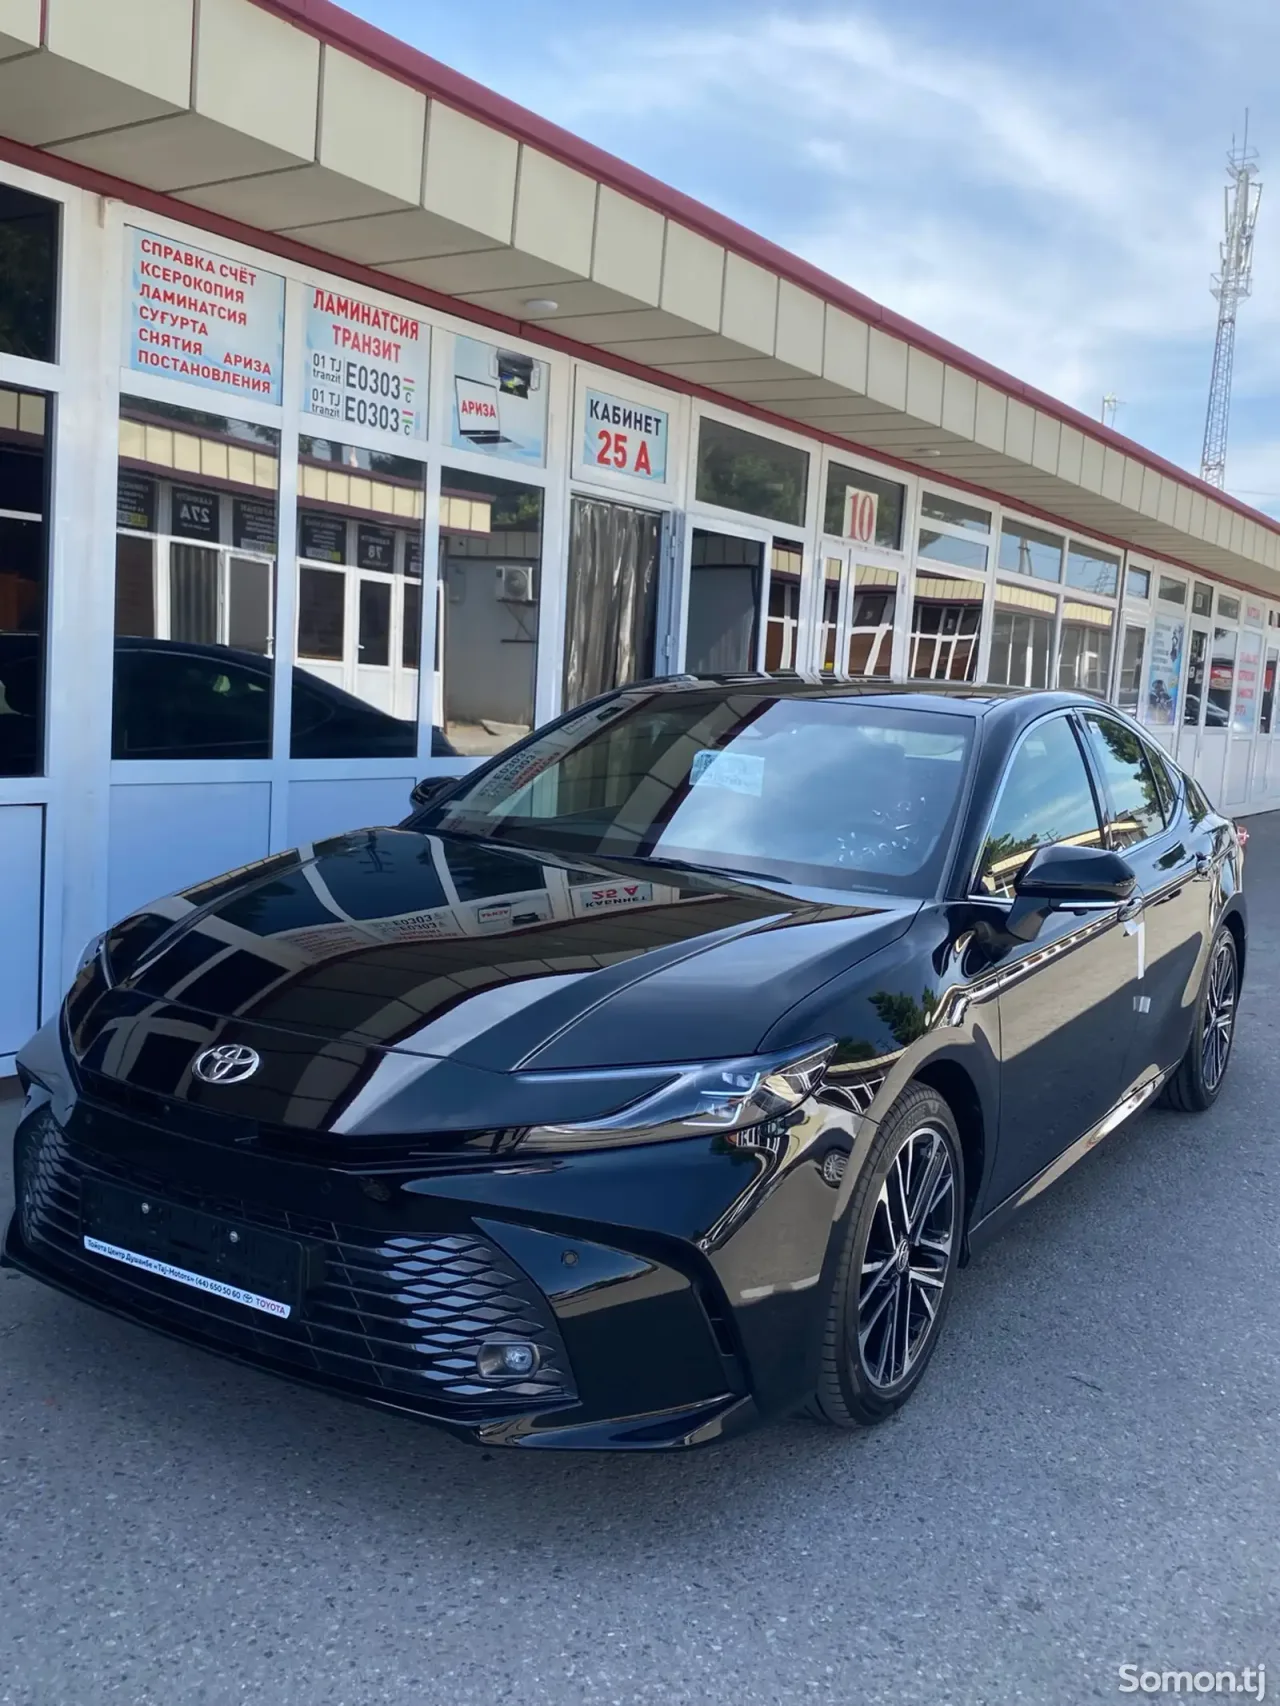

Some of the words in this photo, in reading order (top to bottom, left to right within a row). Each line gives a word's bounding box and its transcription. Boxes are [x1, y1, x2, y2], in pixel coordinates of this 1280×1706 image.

[140, 260, 244, 304] КСЕРОКОПИЯ
[141, 239, 214, 274] СПРАВКА
[219, 265, 257, 287] СЧЁТ
[139, 283, 247, 326] ЛАМИНАТСИЯ
[313, 289, 419, 341] ЛАМИНАТСИЯ
[138, 328, 203, 356] СНЯТИЯ
[223, 352, 272, 376] АРИЗА
[313, 353, 325, 369] 01
[330, 357, 342, 373] TJ
[332, 324, 402, 364] ТРАНЗИТ
[138, 350, 271, 394] ПОСТАНОВЛЕНИЯ
[313, 368, 341, 384] tranzit
[346, 361, 400, 400] E0303
[312, 388, 324, 403] 01
[328, 392, 340, 407] TJ
[312, 402, 340, 418] tranzit
[345, 396, 399, 432] E0303
[461, 400, 497, 418] АРИЗА
[589, 399, 662, 436] КАБИНЕТ
[597, 430, 628, 469] 25
[634, 441, 652, 475] А
[849, 491, 874, 542] 10
[195, 1277, 209, 1289] (44)
[209, 1282, 222, 1293] 650
[222, 1286, 231, 1296] 50
[231, 1290, 241, 1299] 60
[256, 1298, 285, 1315] TOYOTA
